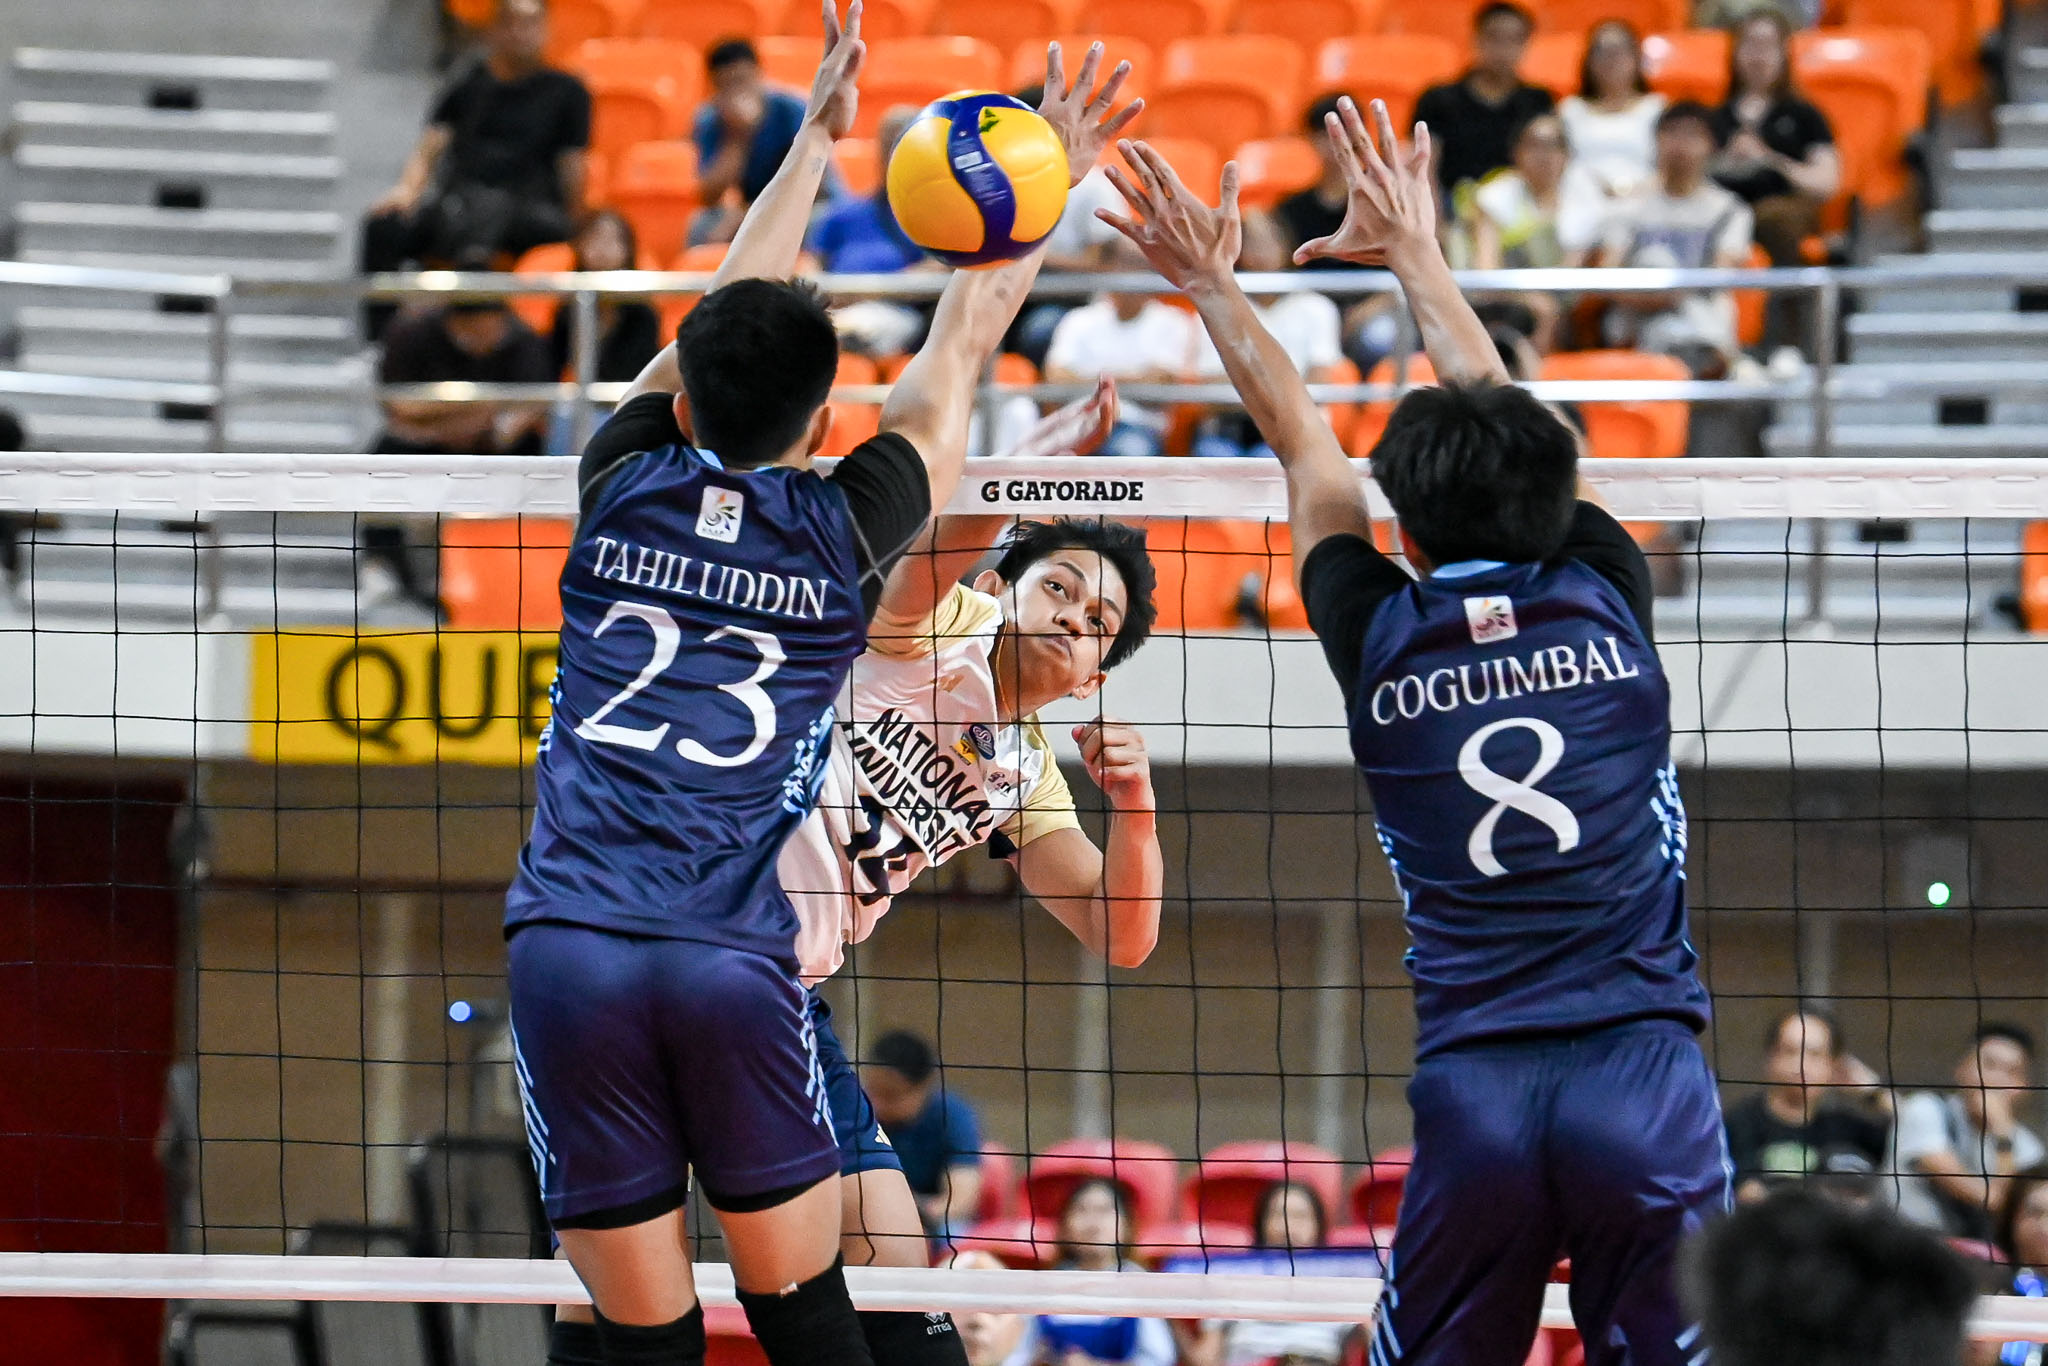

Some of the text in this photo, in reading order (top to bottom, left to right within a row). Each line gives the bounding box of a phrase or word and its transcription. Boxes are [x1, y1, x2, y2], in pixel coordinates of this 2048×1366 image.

[1006, 480, 1144, 502] GATORADE
[592, 536, 830, 621] TAHILUDDIN
[573, 600, 788, 767] 23
[1372, 636, 1640, 726] COGUIMBAL
[866, 707, 995, 842] NATIONAL
[1457, 716, 1581, 878] 8
